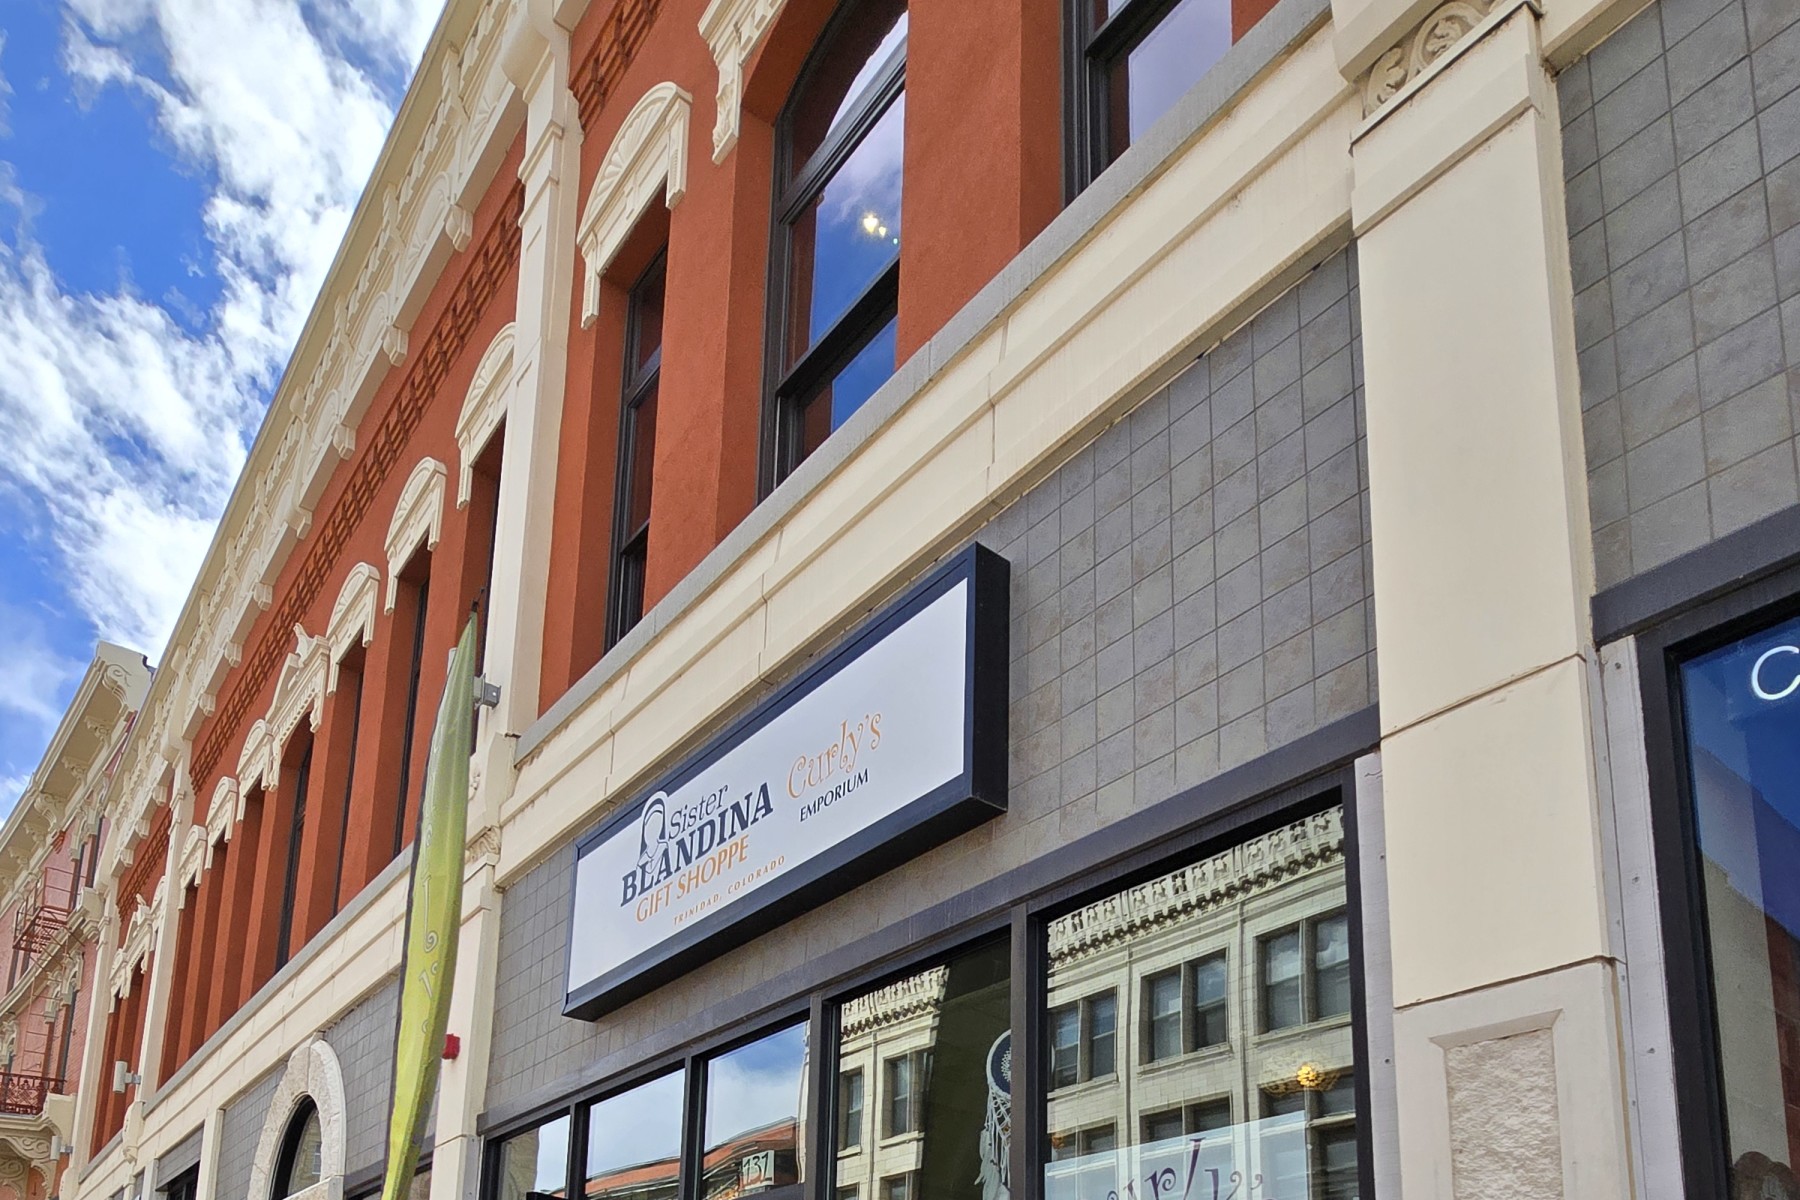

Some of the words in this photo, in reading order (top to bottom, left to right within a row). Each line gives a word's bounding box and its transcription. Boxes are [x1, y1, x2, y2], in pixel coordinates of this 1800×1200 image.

[787, 713, 881, 798] Curly's
[668, 784, 728, 841] Sister
[800, 768, 868, 822] EMPORIUM
[620, 782, 773, 907] BLANDINA
[636, 881, 673, 924] GIFT
[676, 834, 749, 899] SHOPPE
[673, 893, 722, 926] TRINIDAD,
[728, 855, 785, 895] COLORADO
[743, 1152, 772, 1186] 131
